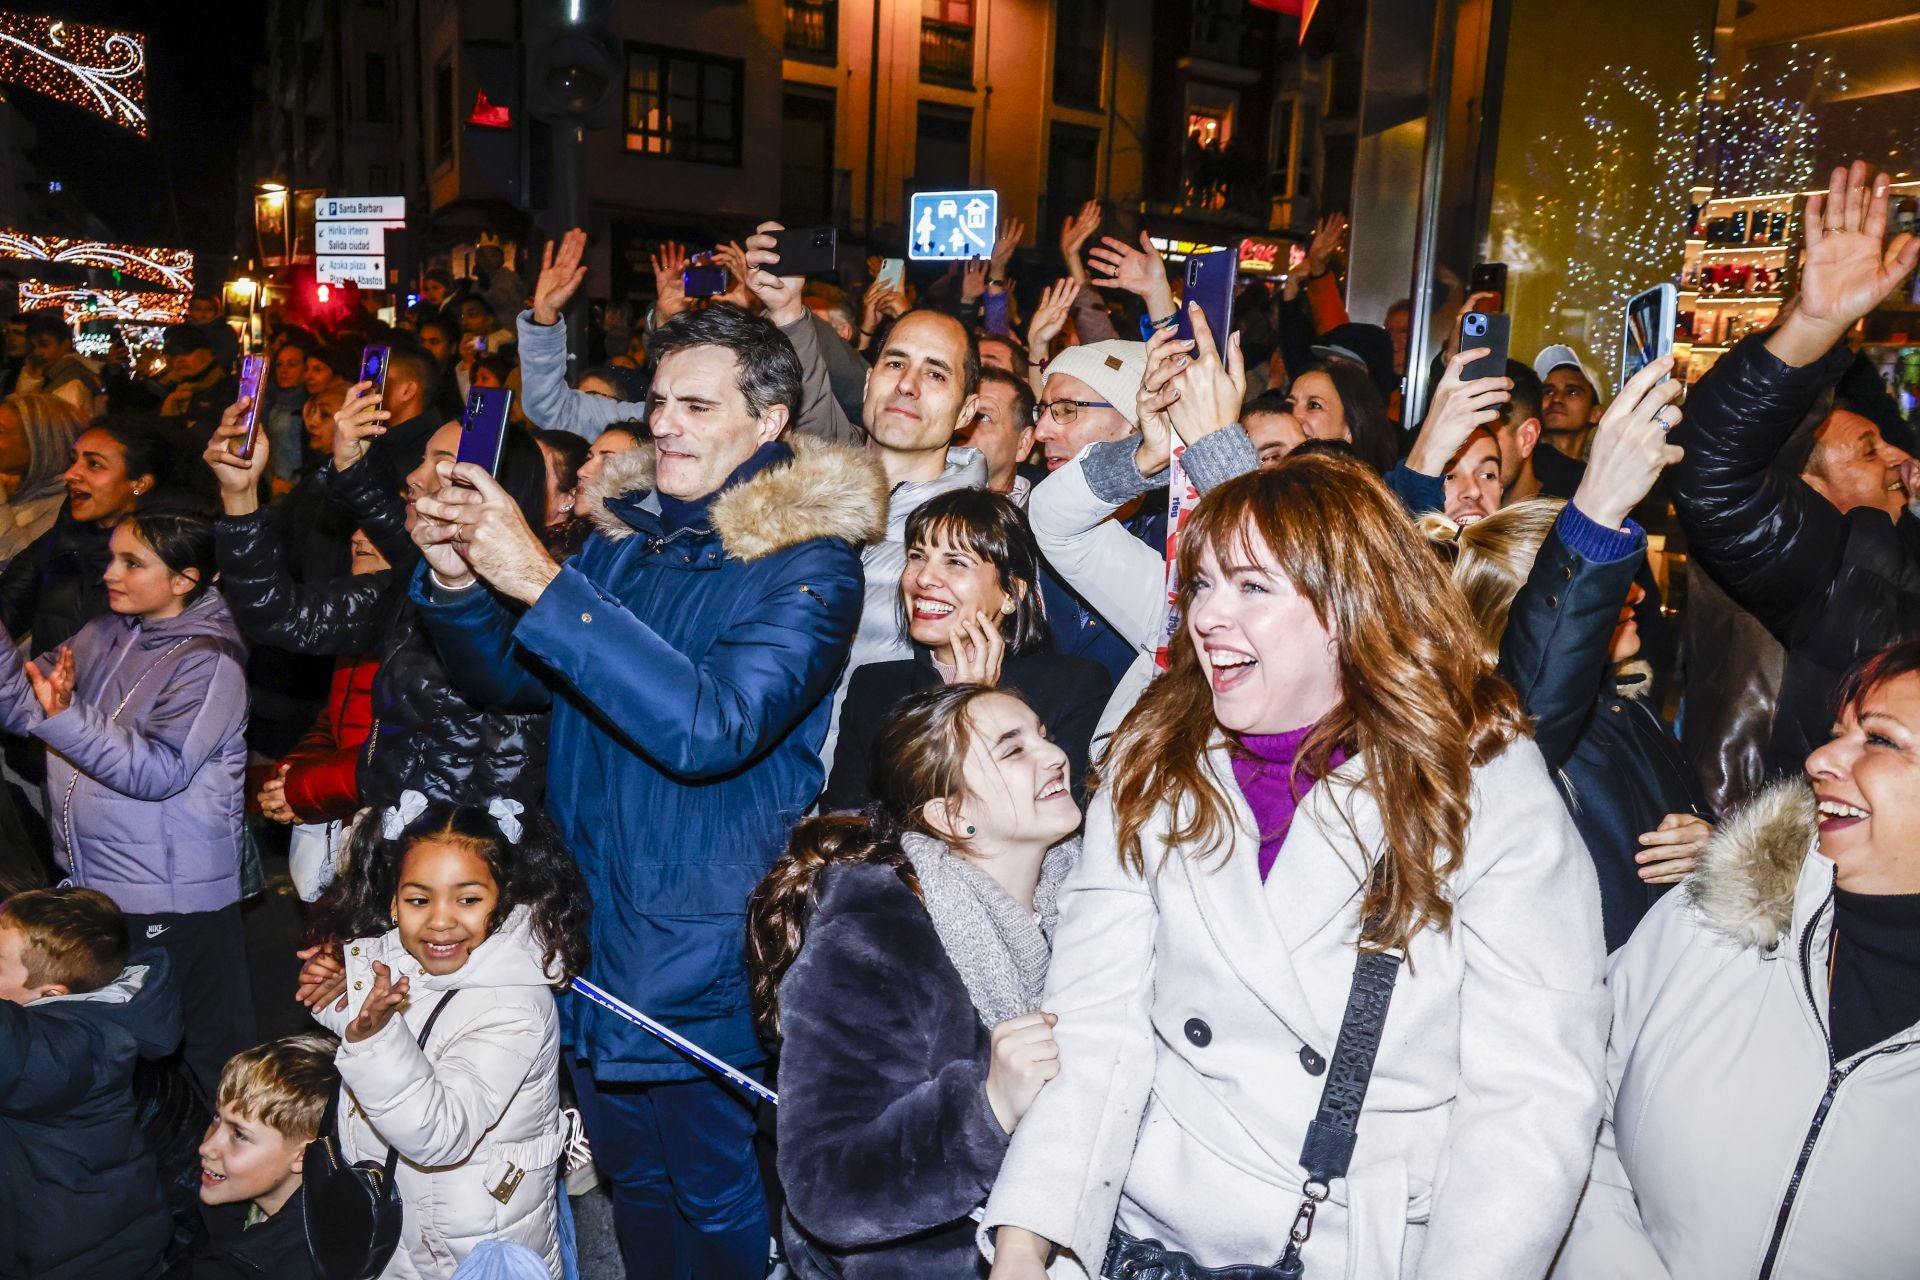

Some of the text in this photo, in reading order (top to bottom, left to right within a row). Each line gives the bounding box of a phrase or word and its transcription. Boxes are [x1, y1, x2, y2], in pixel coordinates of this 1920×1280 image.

[339, 204, 356, 213] Santa
[358, 204, 383, 213] Barbara
[328, 226, 347, 235] Hiriko
[328, 240, 370, 250] Salida ciudad
[330, 260, 366, 271] Azoka plaza
[358, 275, 383, 285] Abastos
[148, 924, 163, 933] NIKE
